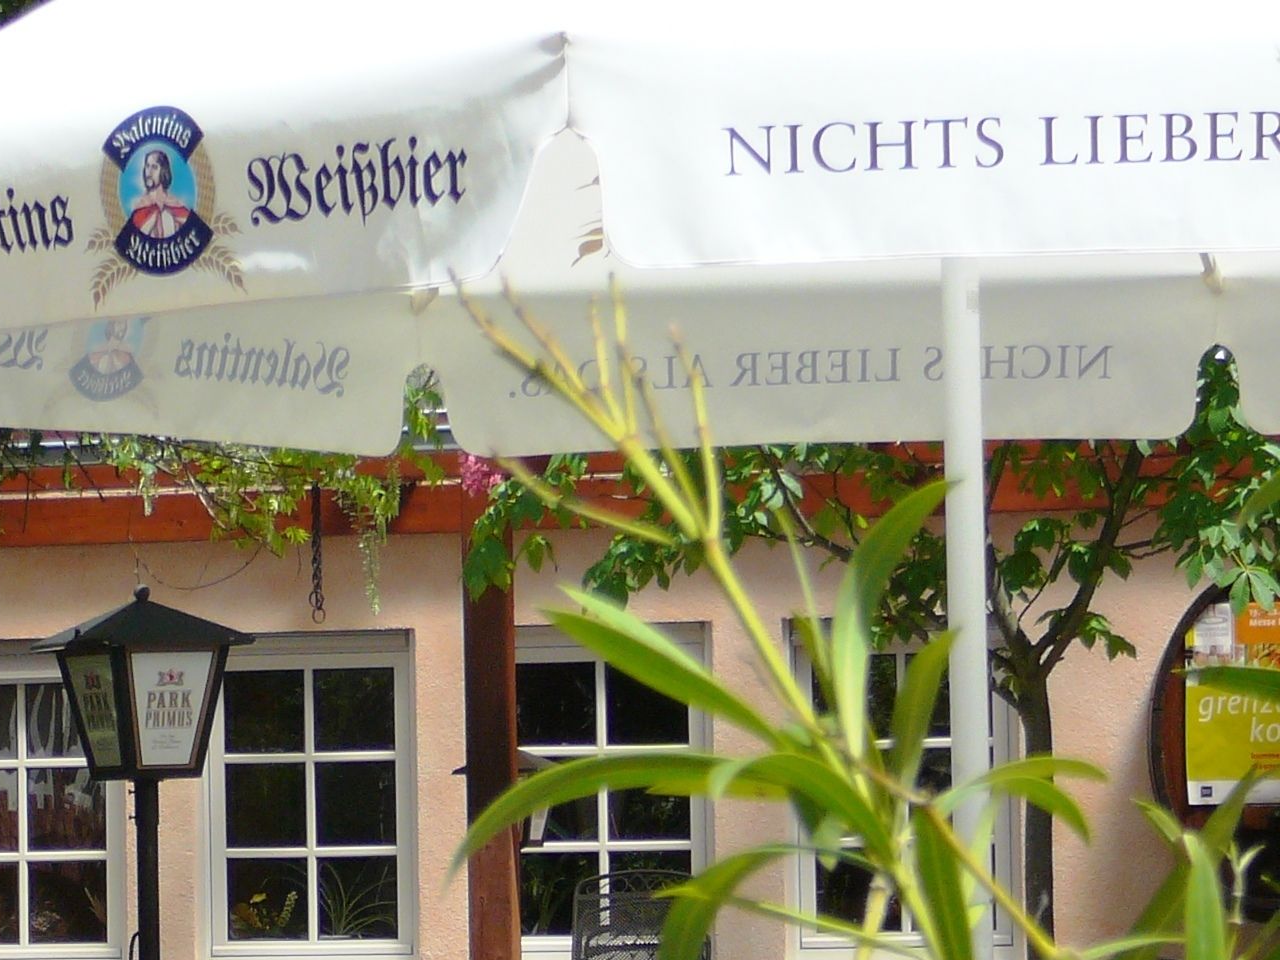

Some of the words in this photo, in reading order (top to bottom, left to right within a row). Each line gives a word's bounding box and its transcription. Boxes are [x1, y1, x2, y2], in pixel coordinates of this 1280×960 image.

[113, 114, 192, 159] Valentins
[723, 117, 1004, 176] NICHTS
[1039, 111, 1280, 165] LIEBER
[247, 136, 467, 227] Weißbier
[126, 229, 201, 269] Weißbier
[144, 710, 193, 729] PRIMUS
[147, 690, 192, 709] PARK
